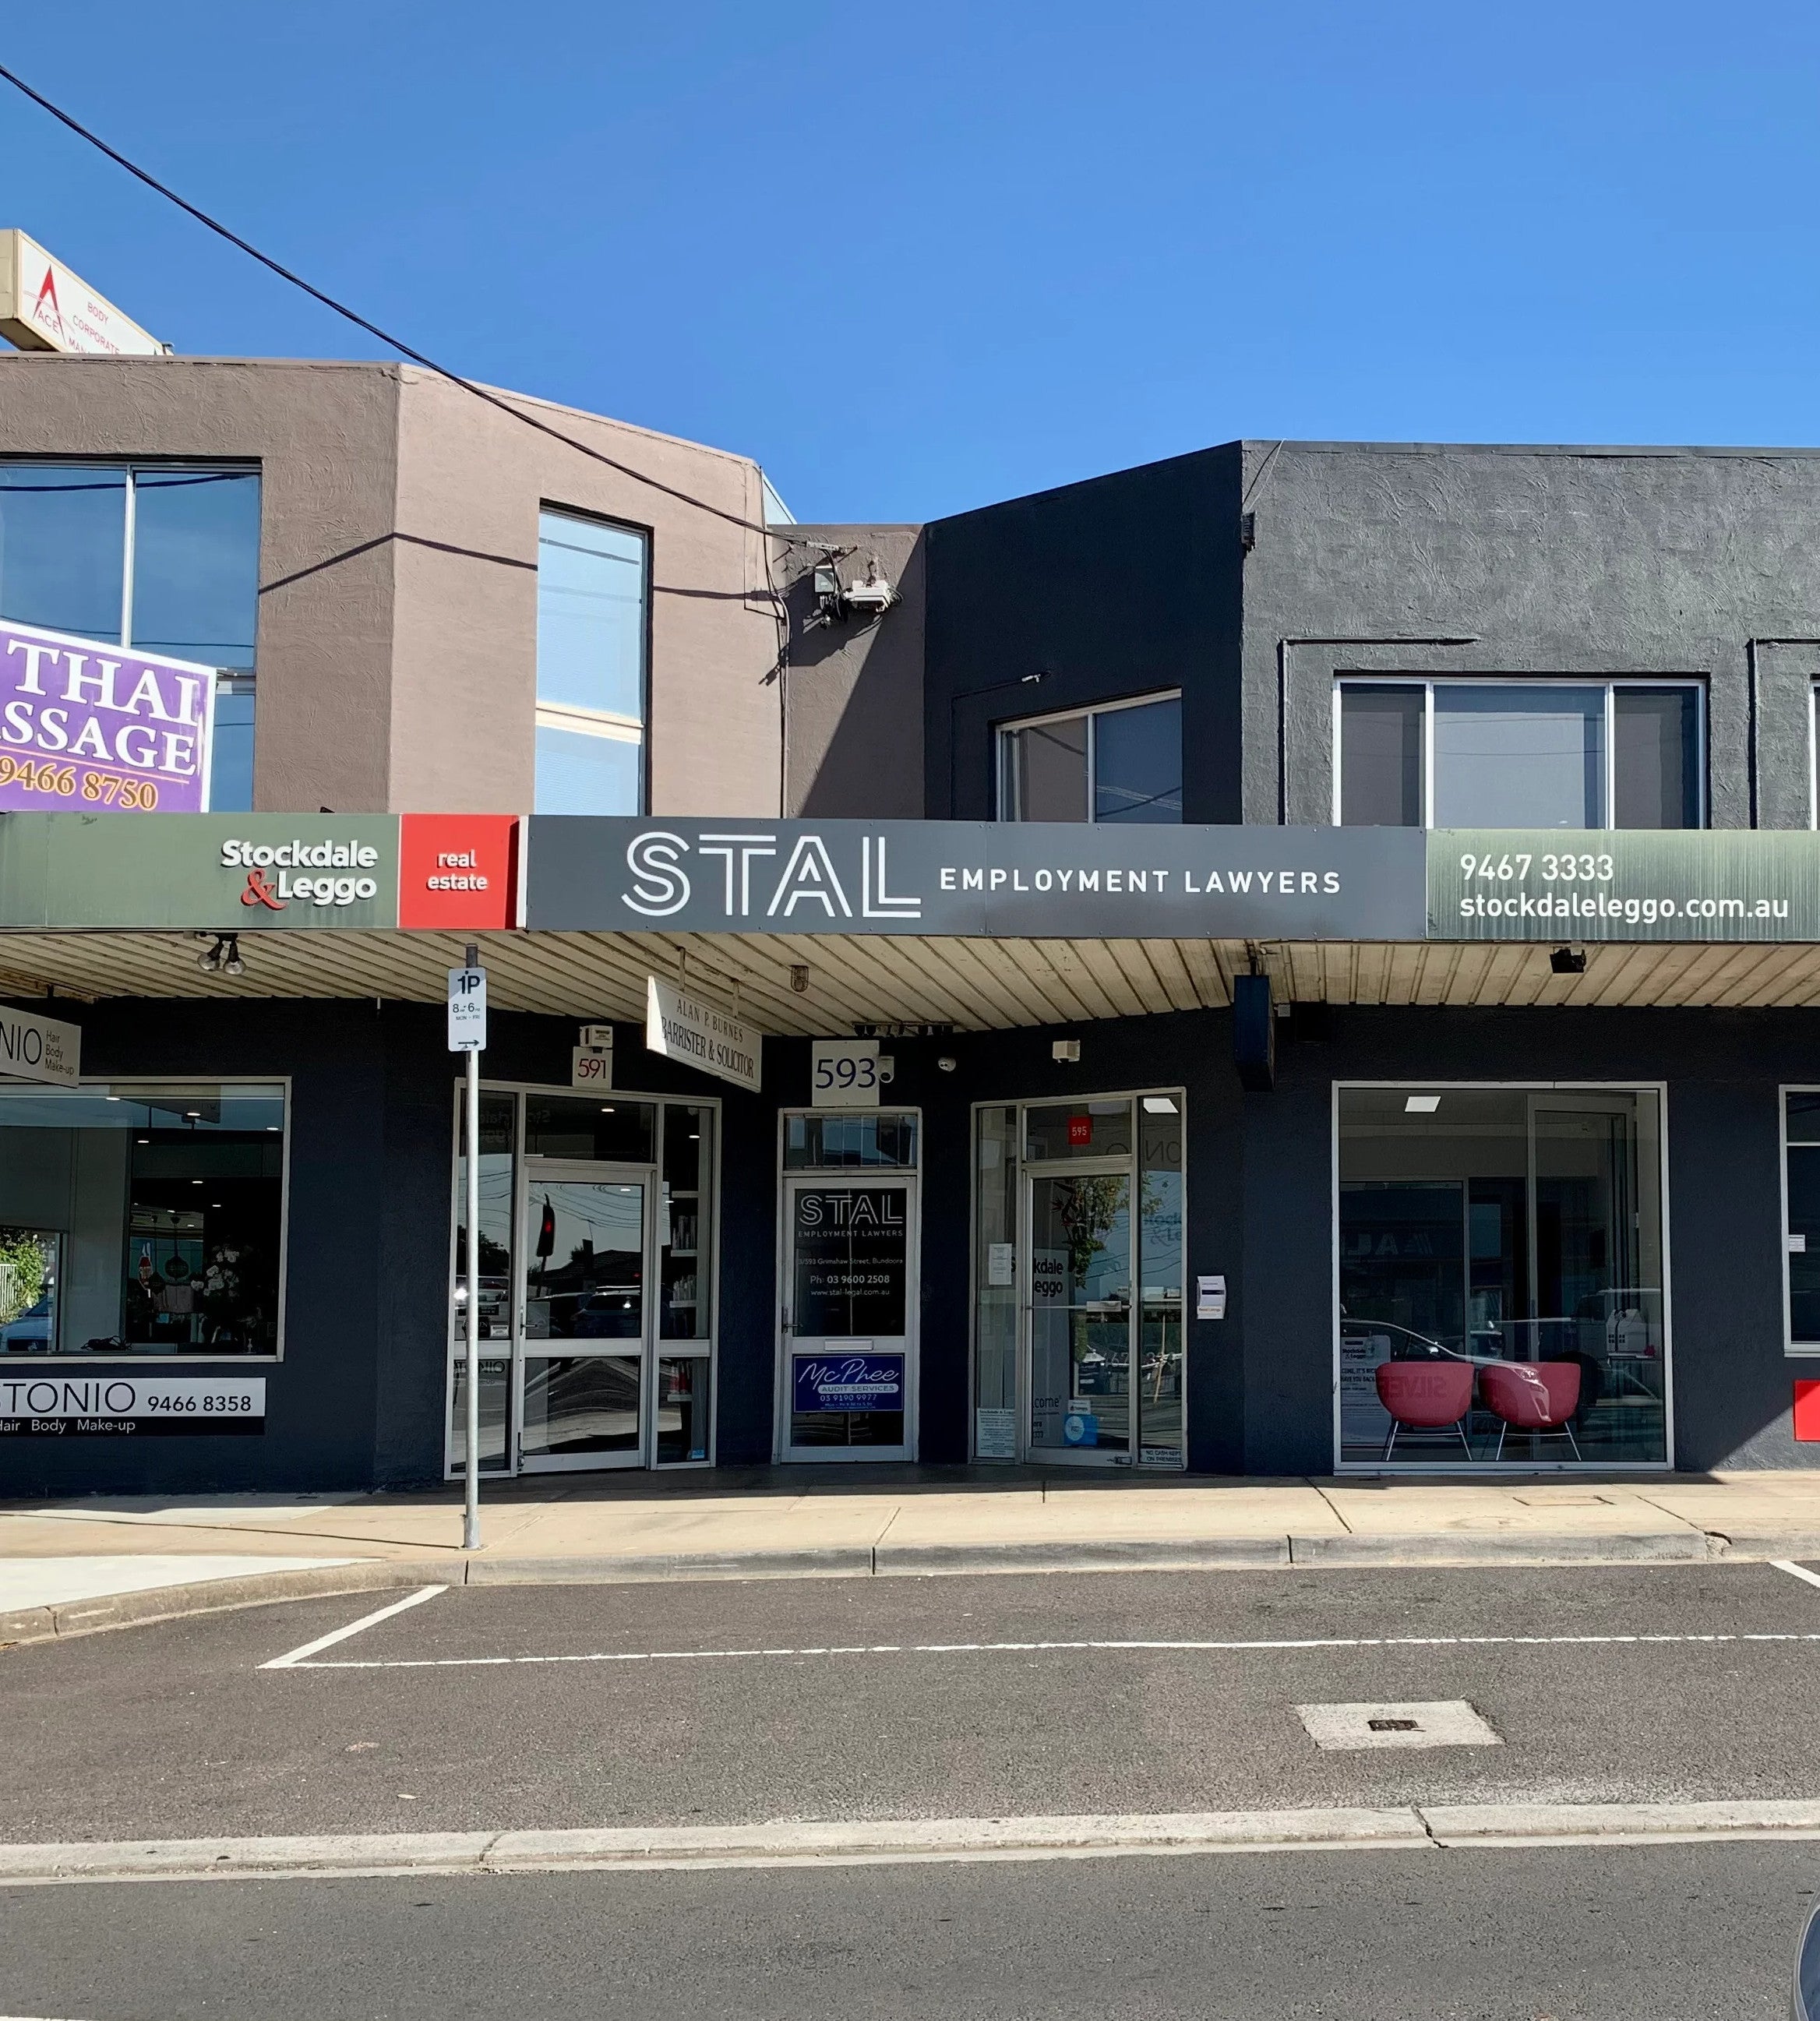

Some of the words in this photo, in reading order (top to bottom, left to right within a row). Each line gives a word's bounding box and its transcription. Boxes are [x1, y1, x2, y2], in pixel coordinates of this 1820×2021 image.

[38, 310, 59, 334] ACE
[87, 302, 108, 323] BODY
[7, 639, 199, 726] THAI
[0, 700, 196, 775] SSAGE
[0, 756, 76, 795] 9466
[82, 771, 157, 810] 8750
[221, 840, 378, 868] Stockdale
[438, 849, 476, 868] real
[621, 831, 922, 919] STAL
[940, 868, 1169, 893] EMPLOYMENT
[1185, 871, 1341, 894] LAWYERS
[1460, 854, 1532, 880] 9467
[1542, 854, 1614, 880] 3333
[277, 871, 377, 905] Leggo
[428, 873, 489, 891] estate
[1459, 893, 1789, 925] stockdaleleggo.com.au
[457, 975, 481, 994] 1P
[676, 999, 700, 1022] ALAN
[712, 1015, 743, 1042] BURNES
[46, 1030, 60, 1042] Hair
[661, 1016, 706, 1058] BARRISTER
[708, 1039, 715, 1061] &
[717, 1043, 754, 1078] SOLICITOR
[45, 1044, 63, 1062] Body
[45, 1058, 75, 1076] Make-up
[577, 1059, 606, 1079] 591
[816, 1058, 876, 1088] 593
[1071, 1126, 1087, 1137] 595
[799, 1194, 903, 1226] STAL
[827, 1275, 839, 1284] 03
[841, 1275, 865, 1284] 9600
[867, 1275, 890, 1284] 2508
[148, 1396, 196, 1412] 9466
[203, 1395, 251, 1412] 8358
[32, 1419, 66, 1434] Body
[77, 1419, 136, 1434] Make-up
